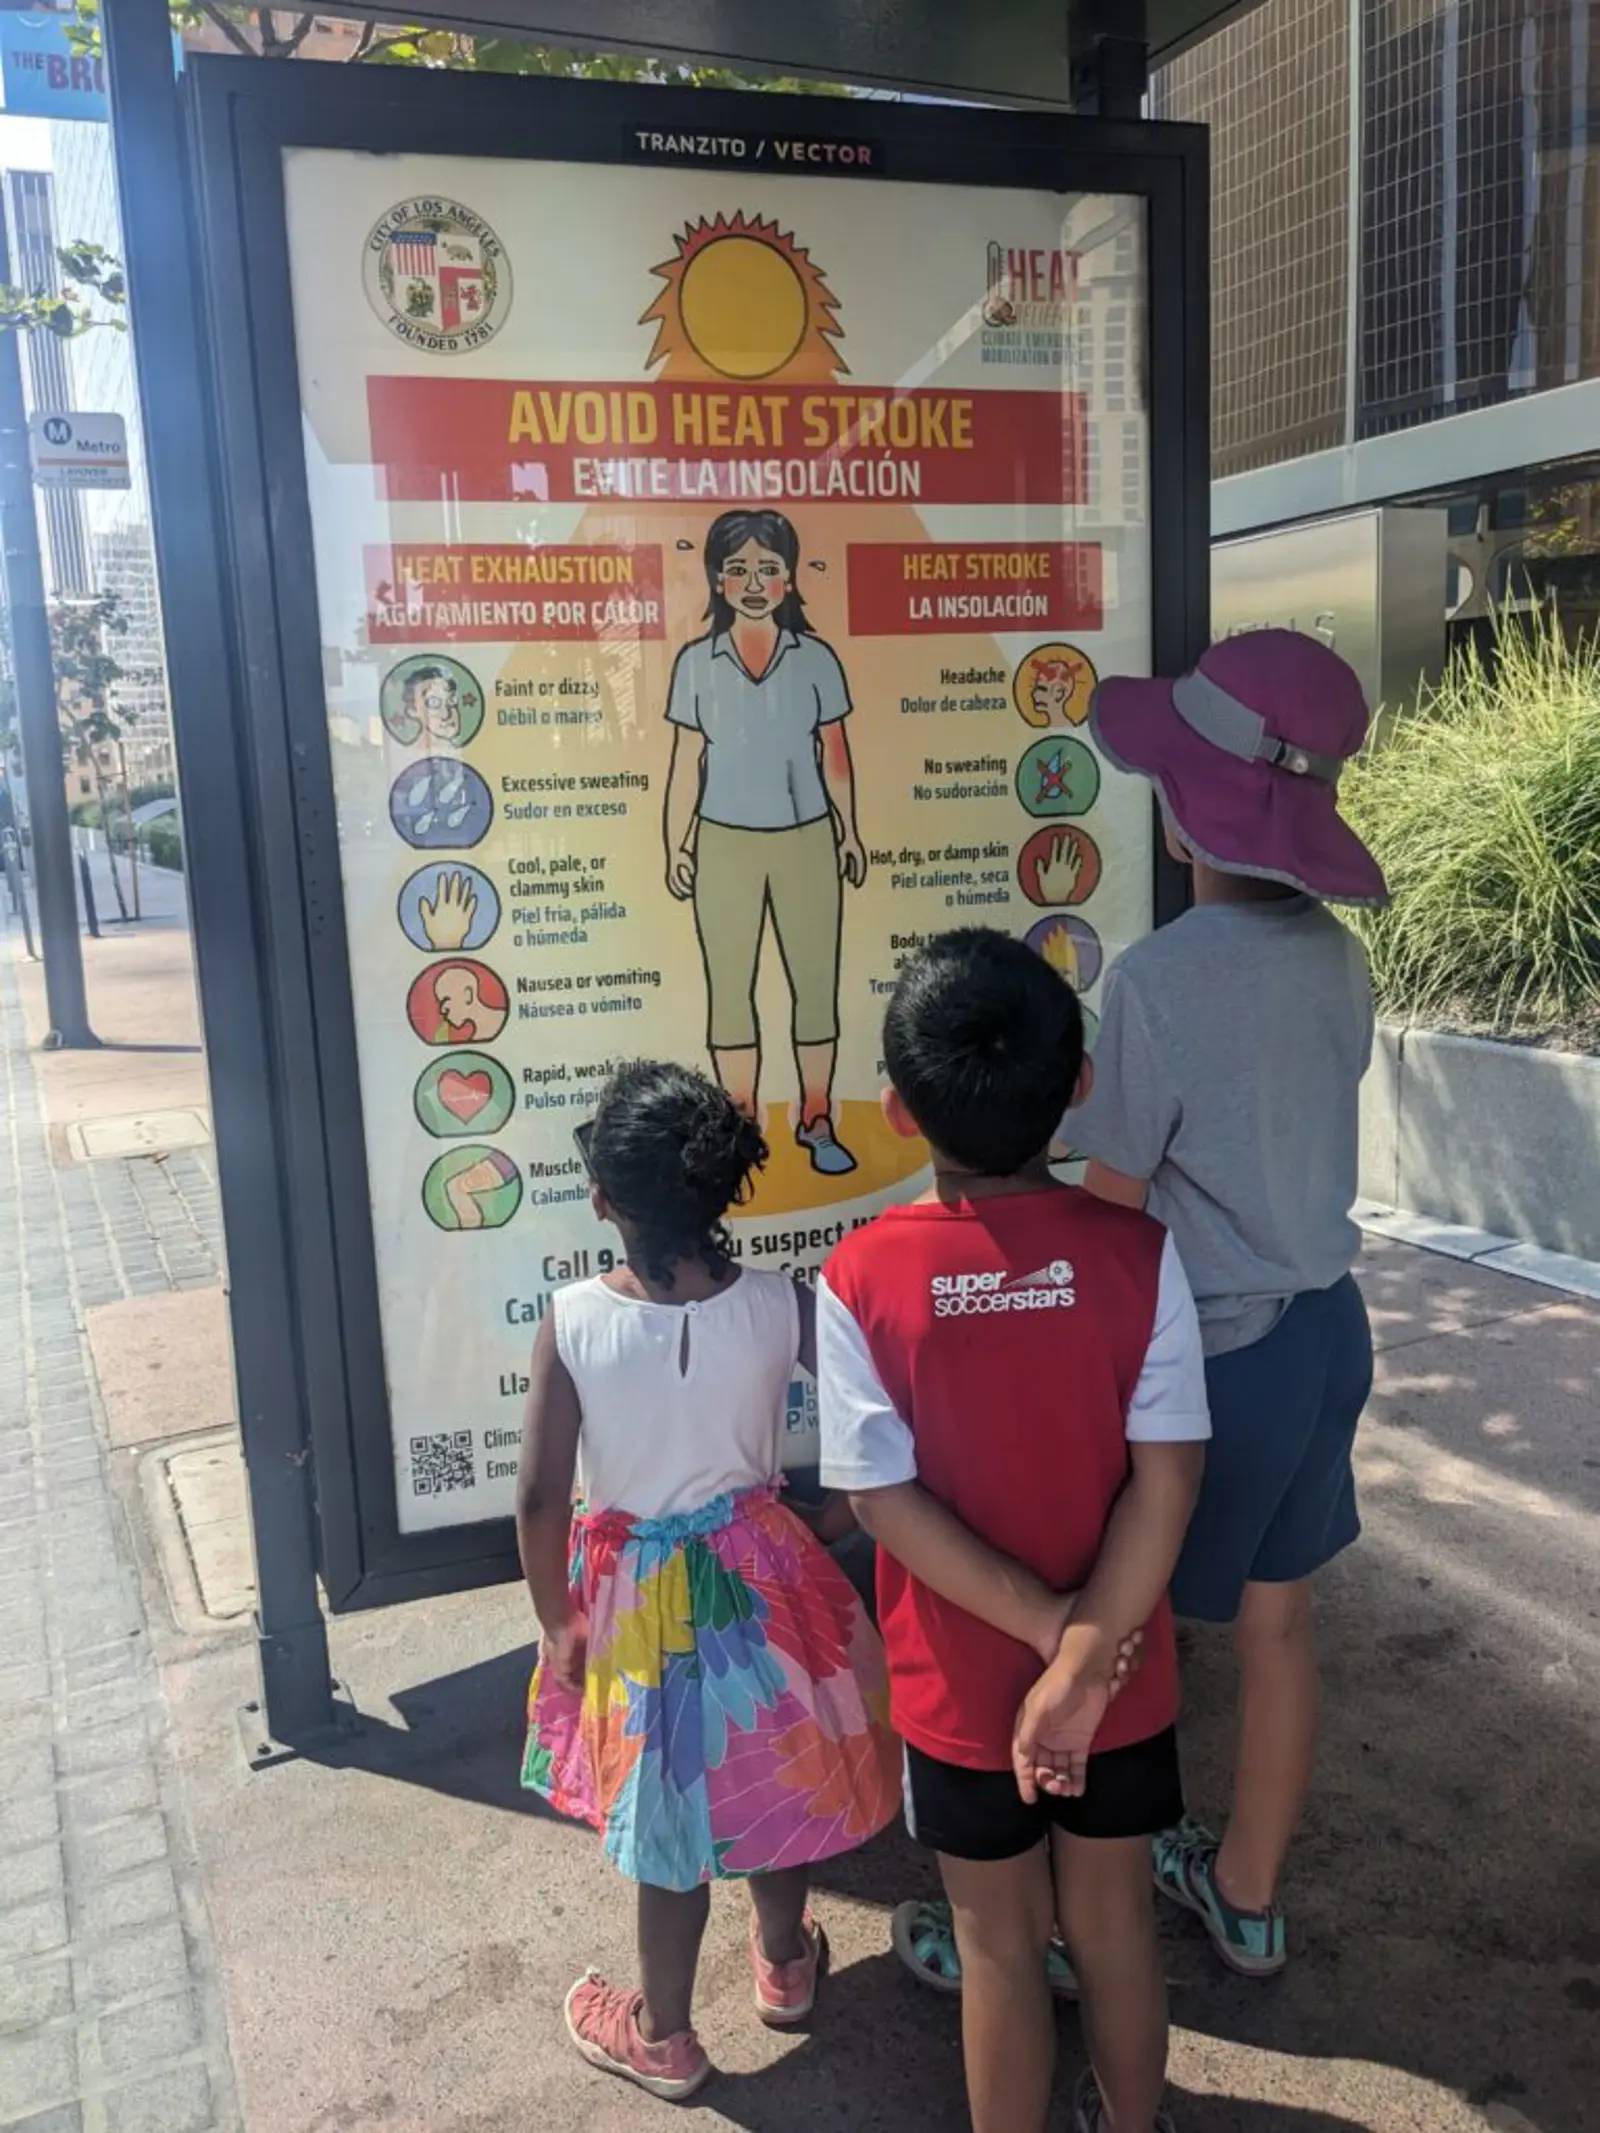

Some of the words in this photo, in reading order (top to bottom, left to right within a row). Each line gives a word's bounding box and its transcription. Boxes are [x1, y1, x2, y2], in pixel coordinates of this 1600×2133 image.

[10, 51, 45, 70] THE
[635, 131, 746, 157] TRANZITO
[755, 140, 766, 159] /
[774, 141, 872, 165] VECTOR
[370, 221, 393, 252] CITY
[391, 205, 410, 223] OF
[413, 200, 443, 214] LOS
[448, 205, 501, 258] ANGELES
[1007, 248, 1083, 302] HEAT
[388, 314, 458, 350] FOUNDED
[464, 321, 495, 347] 1781
[508, 389, 658, 445] AVOID
[672, 392, 790, 447] HEAT
[802, 396, 975, 449] STROKE
[76, 440, 120, 453] Metro
[573, 456, 671, 498] EVITE
[679, 458, 719, 498] LA
[728, 450, 922, 498] INSOLACIÓN
[396, 555, 464, 585] HEAT
[471, 555, 633, 584] EXHAUSTION
[903, 553, 963, 580] HEAT
[965, 552, 1051, 580] STROKE
[375, 600, 536, 628] AGOTAMIENTO
[542, 601, 587, 626] POR
[591, 600, 660, 625] CALOR
[909, 596, 933, 619] LA
[937, 590, 1049, 618] INSOLACIÓN
[940, 666, 1005, 685] Headache
[495, 679, 534, 697] Faint
[539, 682, 554, 695] or
[558, 677, 600, 699] dizzy
[901, 696, 937, 714] Dolor
[940, 696, 957, 712] de
[959, 694, 1007, 711] cabeza
[497, 707, 537, 726] Débil
[541, 712, 550, 725] o
[924, 757, 944, 775] No
[945, 756, 1007, 775] sweating
[501, 773, 576, 793] Excessive
[580, 770, 649, 792] sweating
[913, 784, 933, 801] No
[935, 781, 1008, 799] sudoración
[503, 802, 549, 820] Sudor
[553, 804, 572, 817] en
[576, 802, 628, 817] exceso
[508, 856, 546, 876] Cool,
[549, 854, 587, 877] pale,
[590, 856, 607, 871] or
[869, 849, 896, 867] Hot,
[899, 846, 925, 867] dry,
[928, 848, 942, 862] or
[944, 844, 980, 864] damp
[982, 841, 1009, 859] skin
[510, 879, 570, 899] clammy
[572, 875, 605, 894] skin
[891, 871, 917, 889] Piel
[920, 869, 978, 888] caliente,
[980, 869, 1009, 884] seca
[945, 893, 954, 907] o
[956, 888, 1010, 906] húmeda
[512, 906, 541, 925] Piel
[580, 901, 627, 923] pálida
[513, 934, 523, 948] o
[526, 926, 589, 946] húmeda
[890, 931, 925, 950] Body
[517, 975, 573, 994] Nausea
[576, 974, 593, 989] or
[595, 967, 662, 988] vomiting
[518, 1000, 575, 1020] Náusea
[578, 1001, 588, 1015] o
[590, 993, 643, 1014] vómito
[523, 1063, 572, 1086] Rapid,
[574, 1059, 614, 1079] weak
[524, 1092, 566, 1110] Pulso
[570, 1086, 603, 1108] rápi
[529, 1158, 582, 1179] Muscle
[542, 1249, 589, 1282] Call
[751, 1221, 844, 1257] suspect
[931, 1270, 1007, 1297] super
[934, 1287, 1076, 1318] soccerstars
